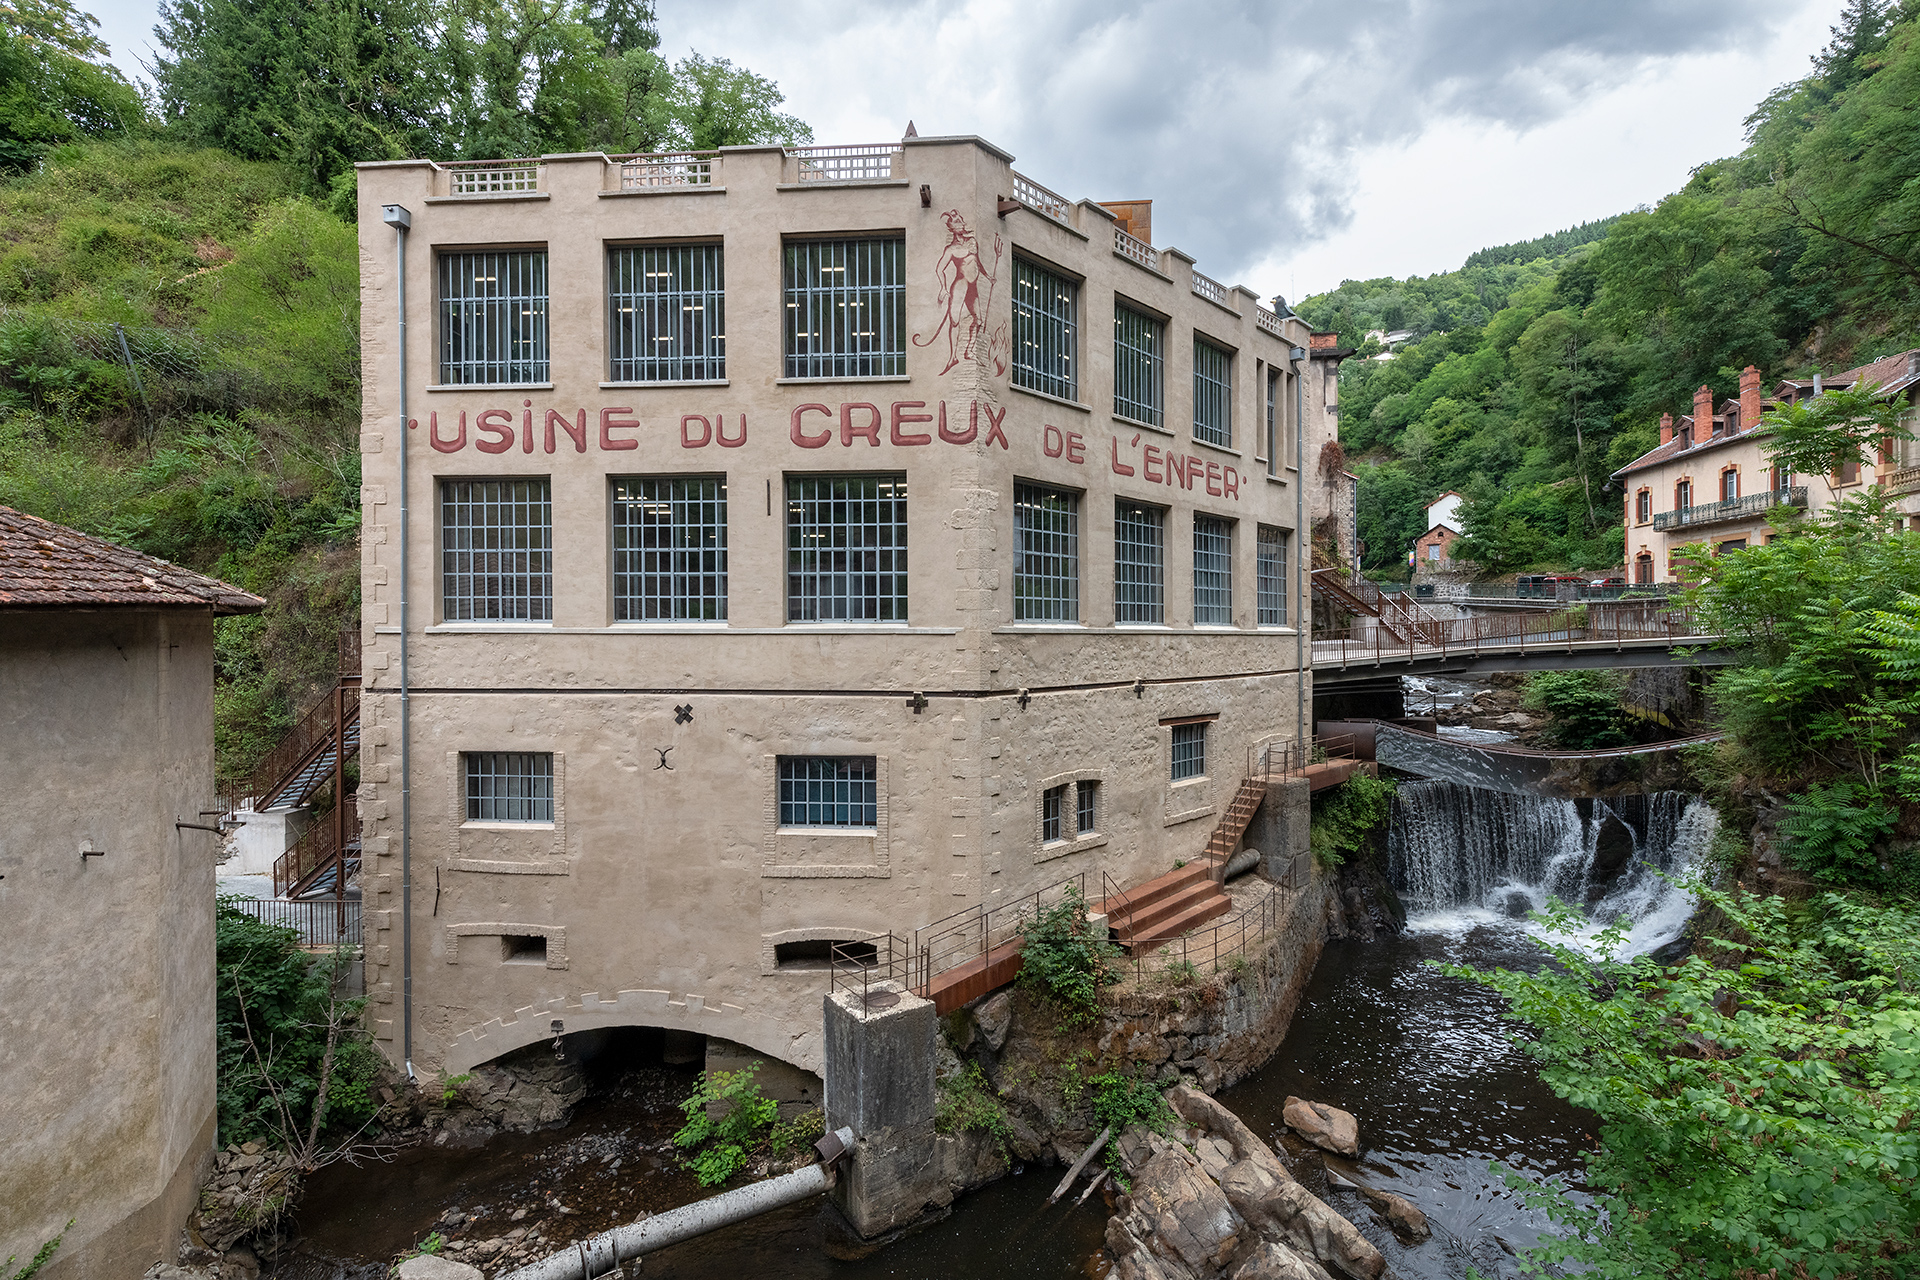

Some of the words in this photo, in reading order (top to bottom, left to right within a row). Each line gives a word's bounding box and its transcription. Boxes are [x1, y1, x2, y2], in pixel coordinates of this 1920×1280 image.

[680, 413, 748, 449] DU
[789, 399, 1009, 451] CREUX
[1043, 423, 1087, 465] DE
[1111, 432, 1239, 501] L'ENFER
